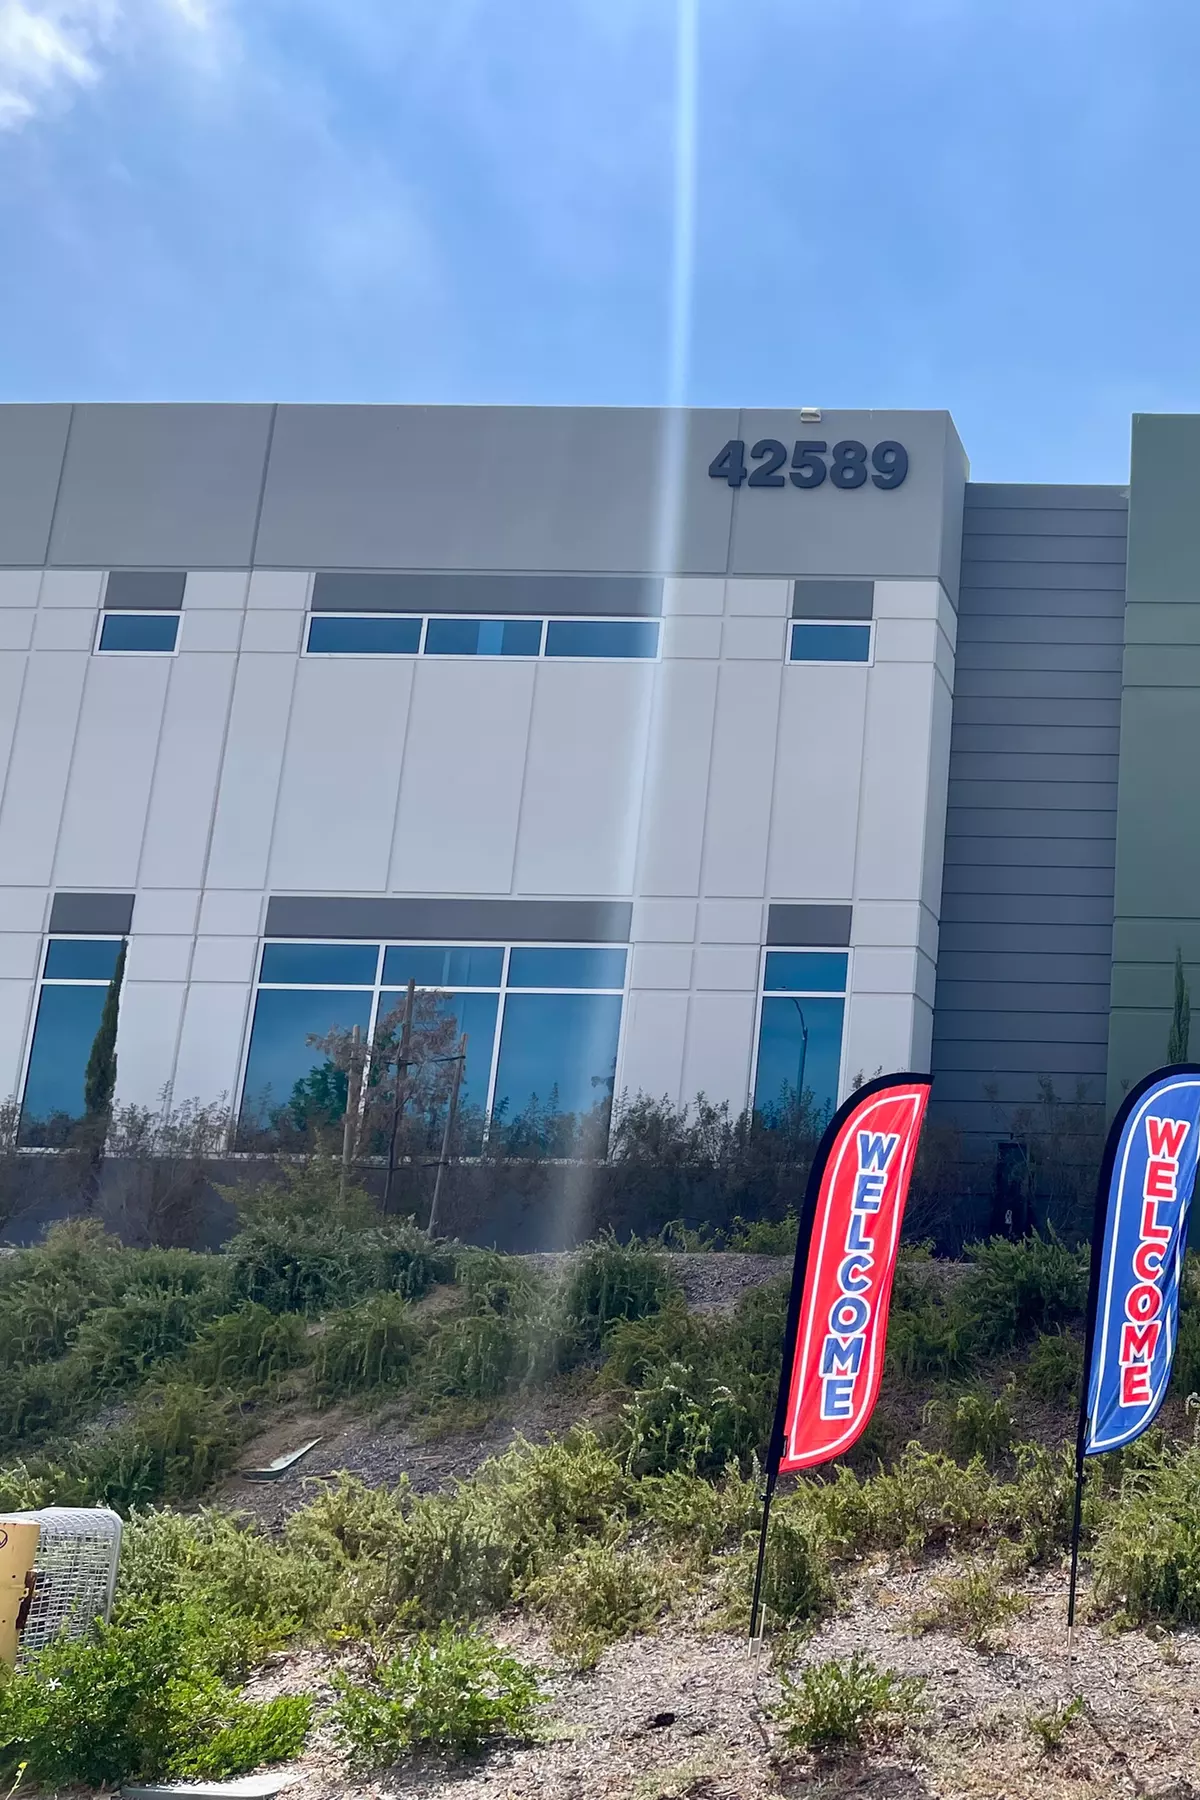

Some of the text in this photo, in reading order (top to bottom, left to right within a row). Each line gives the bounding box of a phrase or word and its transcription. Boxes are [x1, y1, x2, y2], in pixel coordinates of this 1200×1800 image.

[708, 439, 909, 490] 42589
[819, 1131, 899, 1421] WELCOME
[1119, 1116, 1191, 1408] WELCOME
